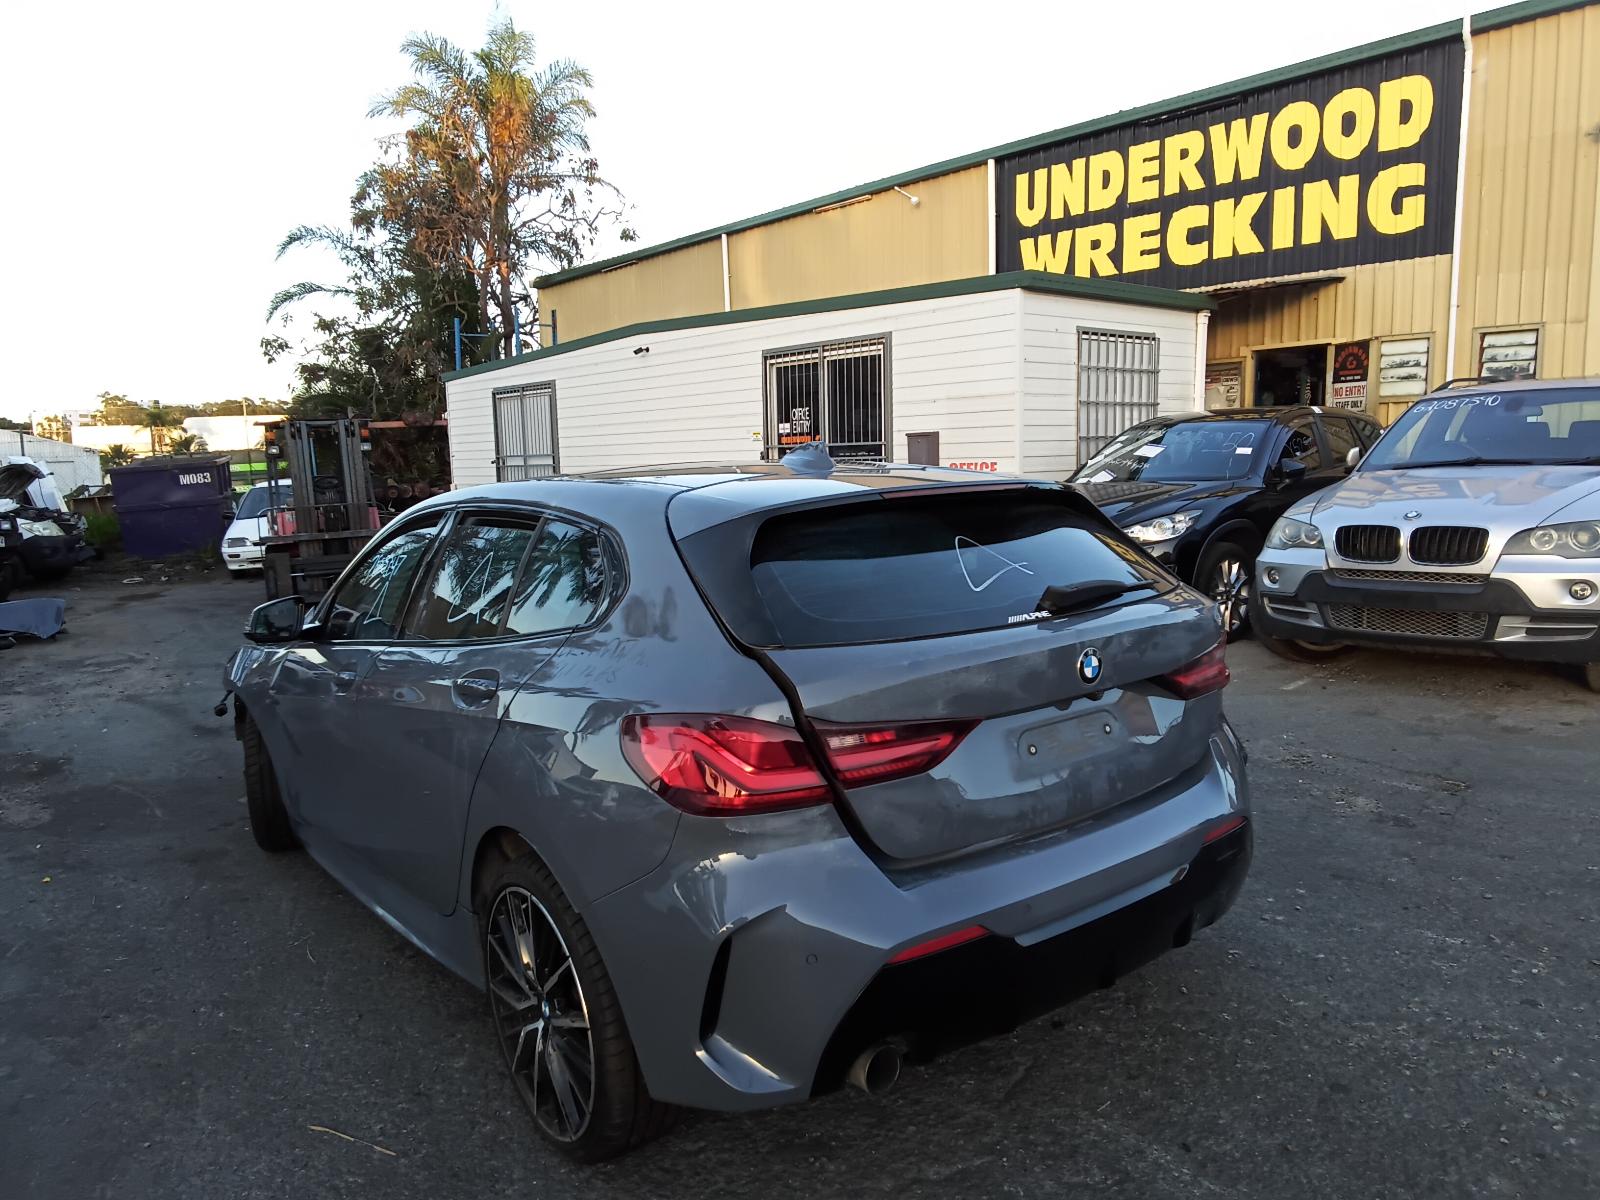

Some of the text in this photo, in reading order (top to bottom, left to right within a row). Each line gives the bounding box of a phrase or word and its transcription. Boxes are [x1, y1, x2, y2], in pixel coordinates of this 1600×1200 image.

[1015, 74, 1434, 228] UNDERWOOD
[1020, 163, 1426, 278] WRECKING
[1334, 385, 1365, 397] NO ENTRY
[1335, 400, 1363, 409] STAFF ONLY
[949, 461, 998, 472] OFFICE
[179, 472, 212, 485] M083
